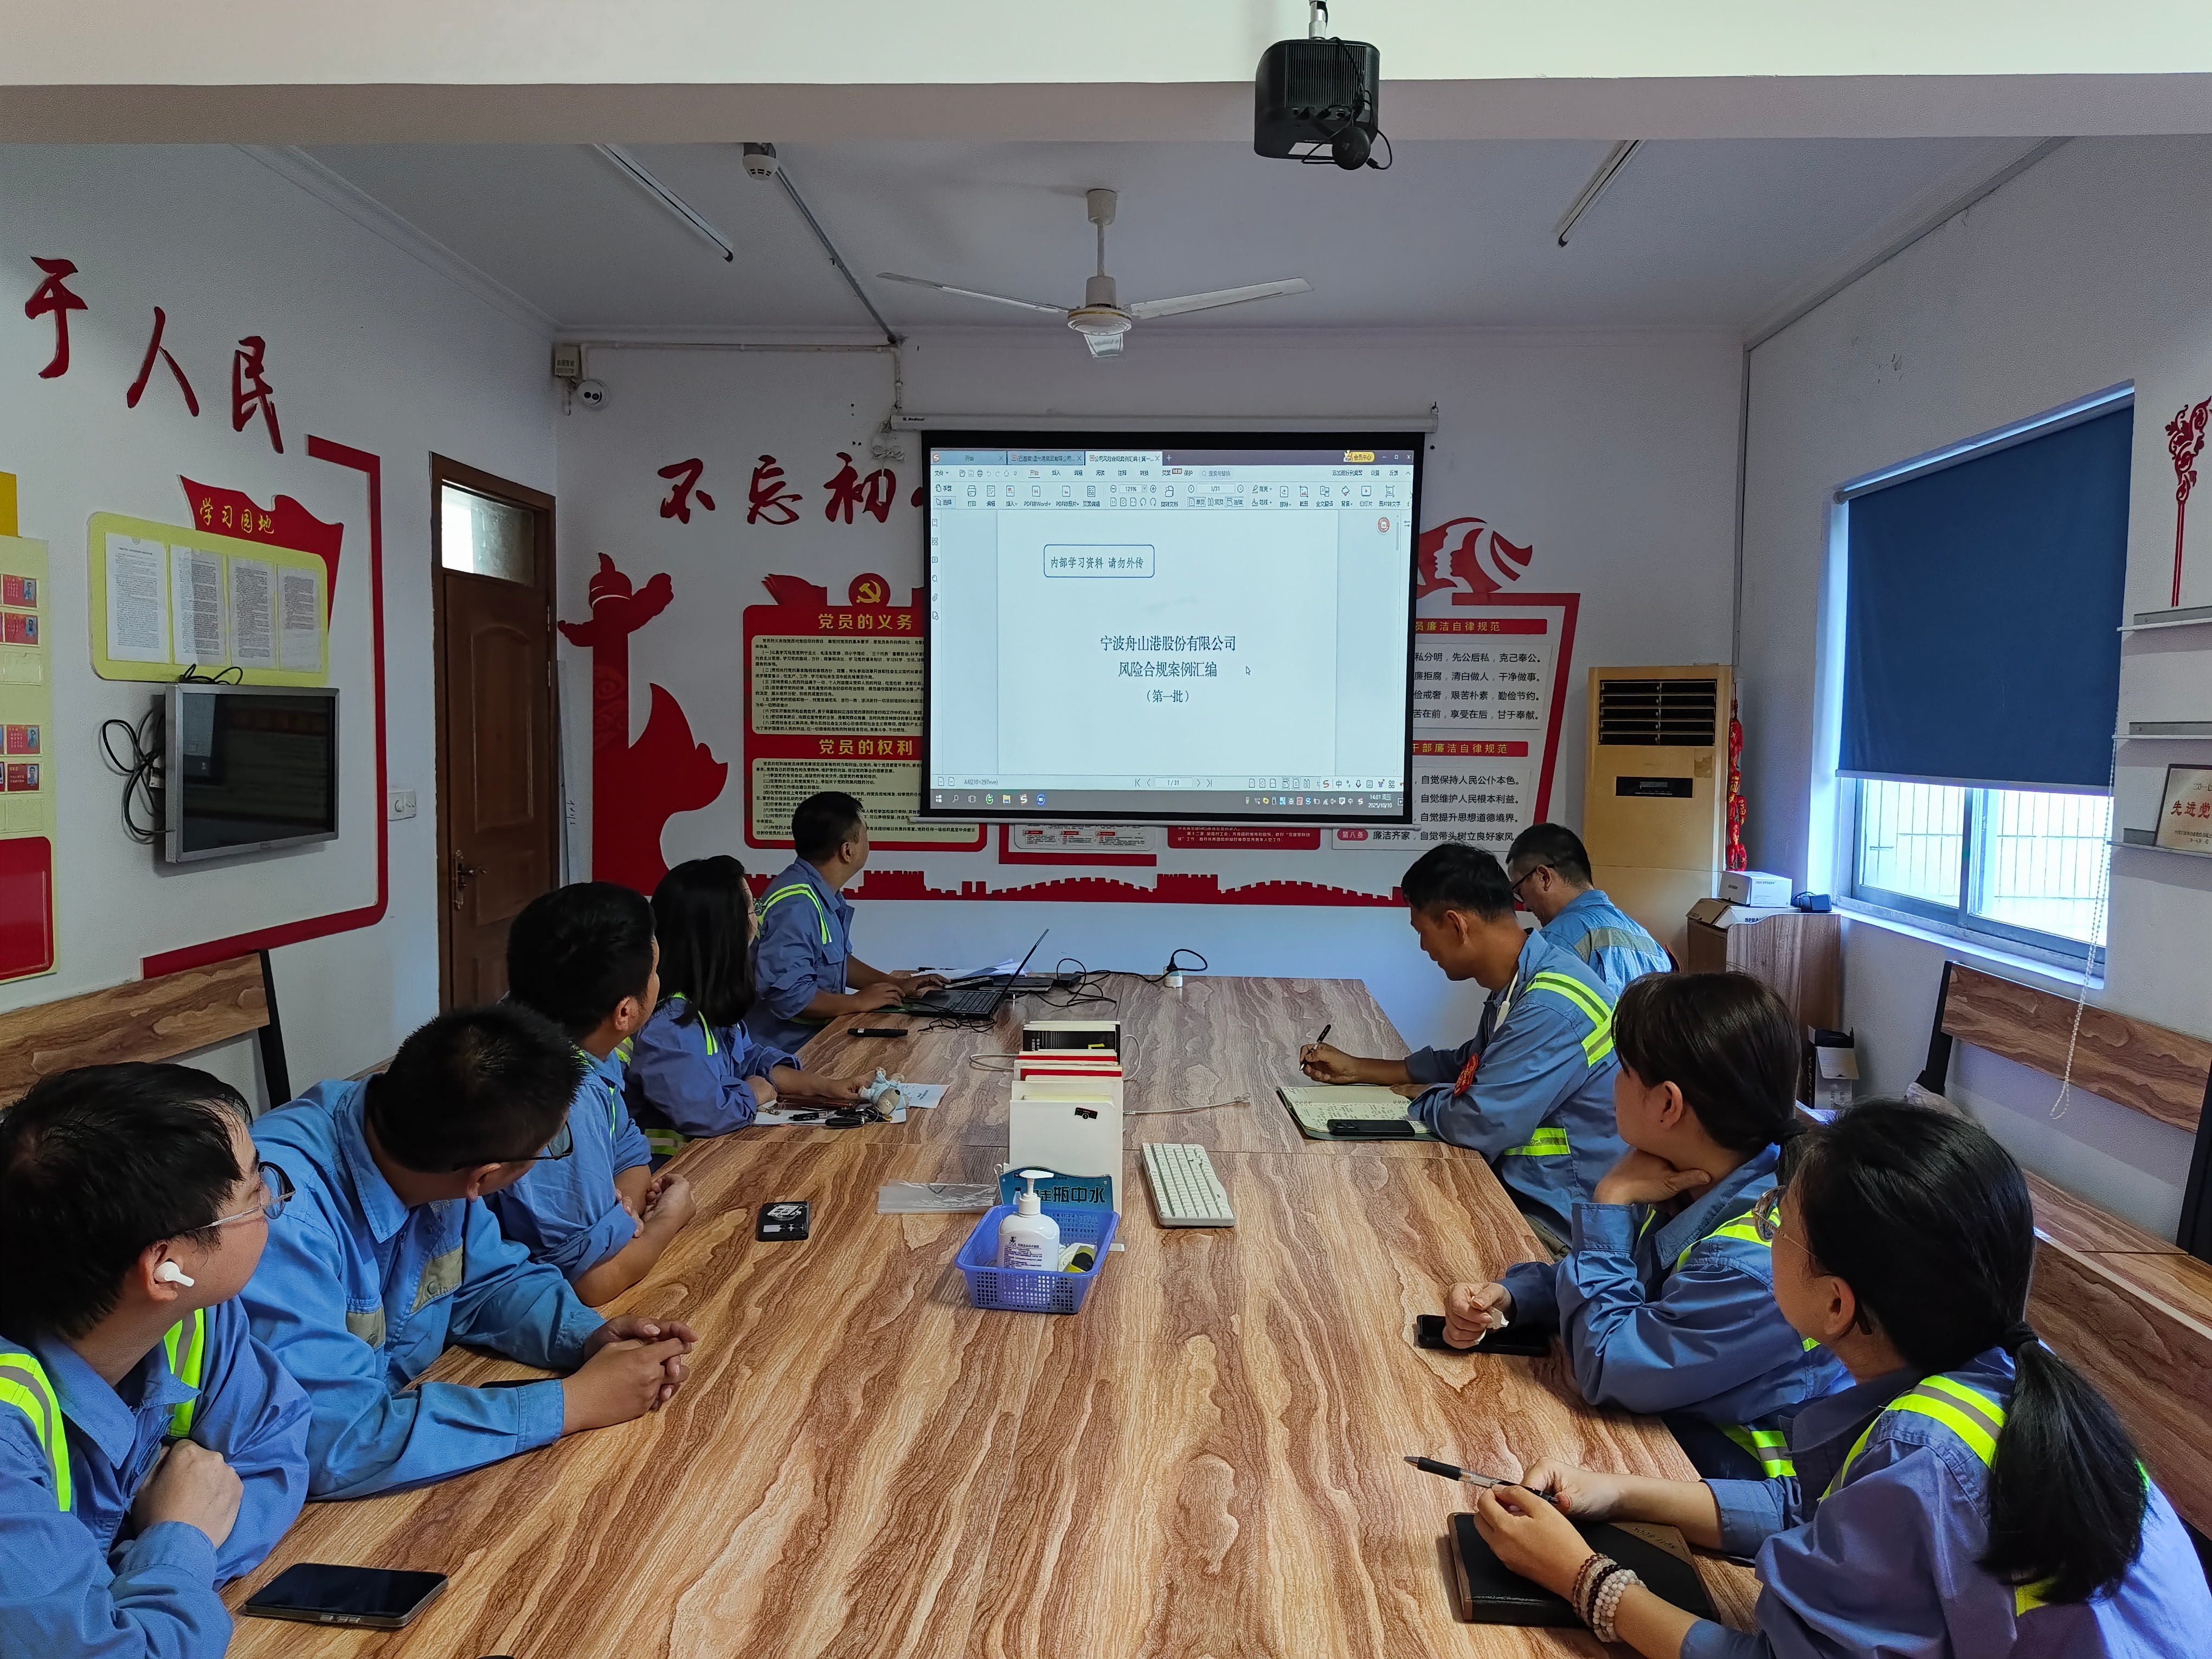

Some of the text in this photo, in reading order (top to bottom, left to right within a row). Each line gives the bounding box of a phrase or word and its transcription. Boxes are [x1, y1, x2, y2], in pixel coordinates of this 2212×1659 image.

[658, 452, 923, 525] 不忘初
[199, 497, 275, 534] 学习园地
[1050, 557, 1144, 569] 内部学习资料 请勿外传
[818, 614, 913, 631] 党员的义务
[1100, 635, 1236, 652] 宁波舟山港股份有限公司
[1118, 661, 1218, 677] 风险合规案例汇编
[1147, 689, 1190, 703] （第一批）
[819, 739, 912, 756] 党员的权利
[2170, 800, 2210, 819] 先进党
[1342, 831, 1365, 839] 第八条
[1034, 1186, 1106, 1204] 走瓶中水
